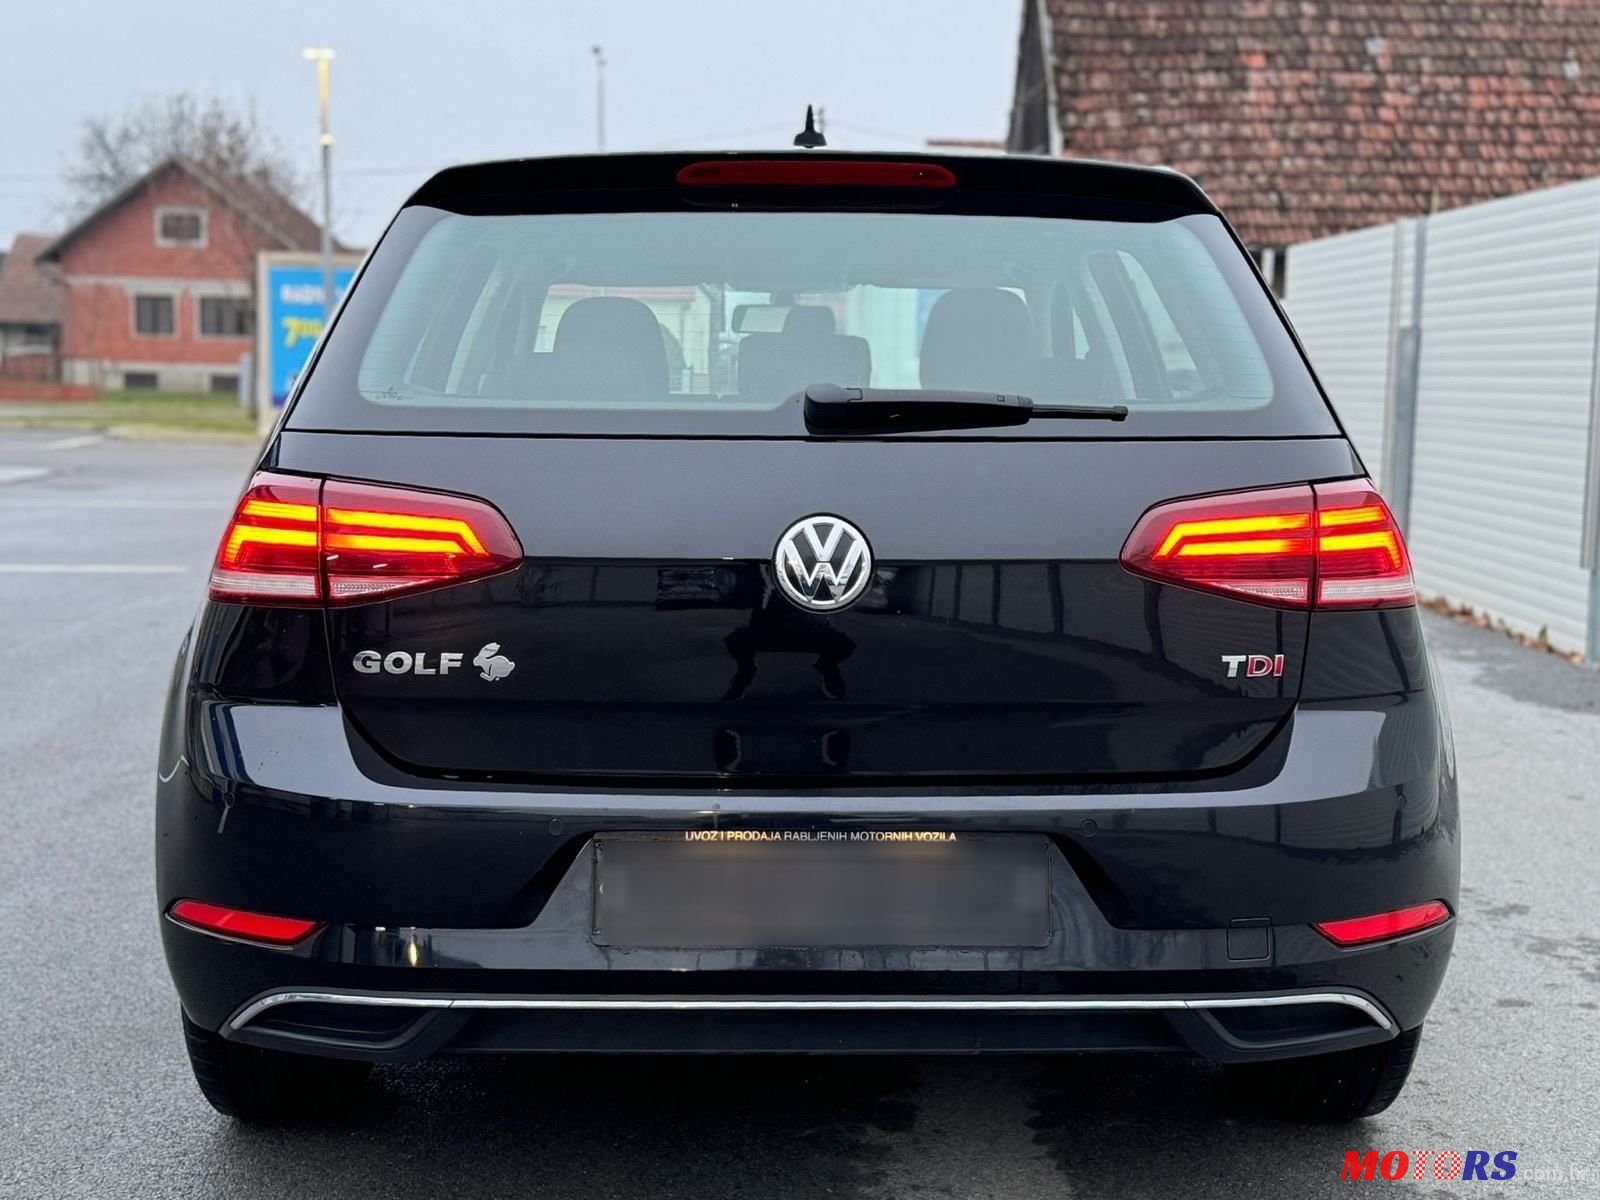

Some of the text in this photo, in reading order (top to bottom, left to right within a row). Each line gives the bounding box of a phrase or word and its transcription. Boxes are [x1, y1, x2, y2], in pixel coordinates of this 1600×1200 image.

[352, 650, 464, 675] GOLF
[1221, 654, 1285, 678] TDI
[685, 831, 718, 841] UVOZ
[727, 831, 782, 841] PRODAJA
[784, 831, 847, 841] RABLJENIH
[850, 831, 913, 841] MOTORNIH
[915, 831, 957, 841] VOZILA
